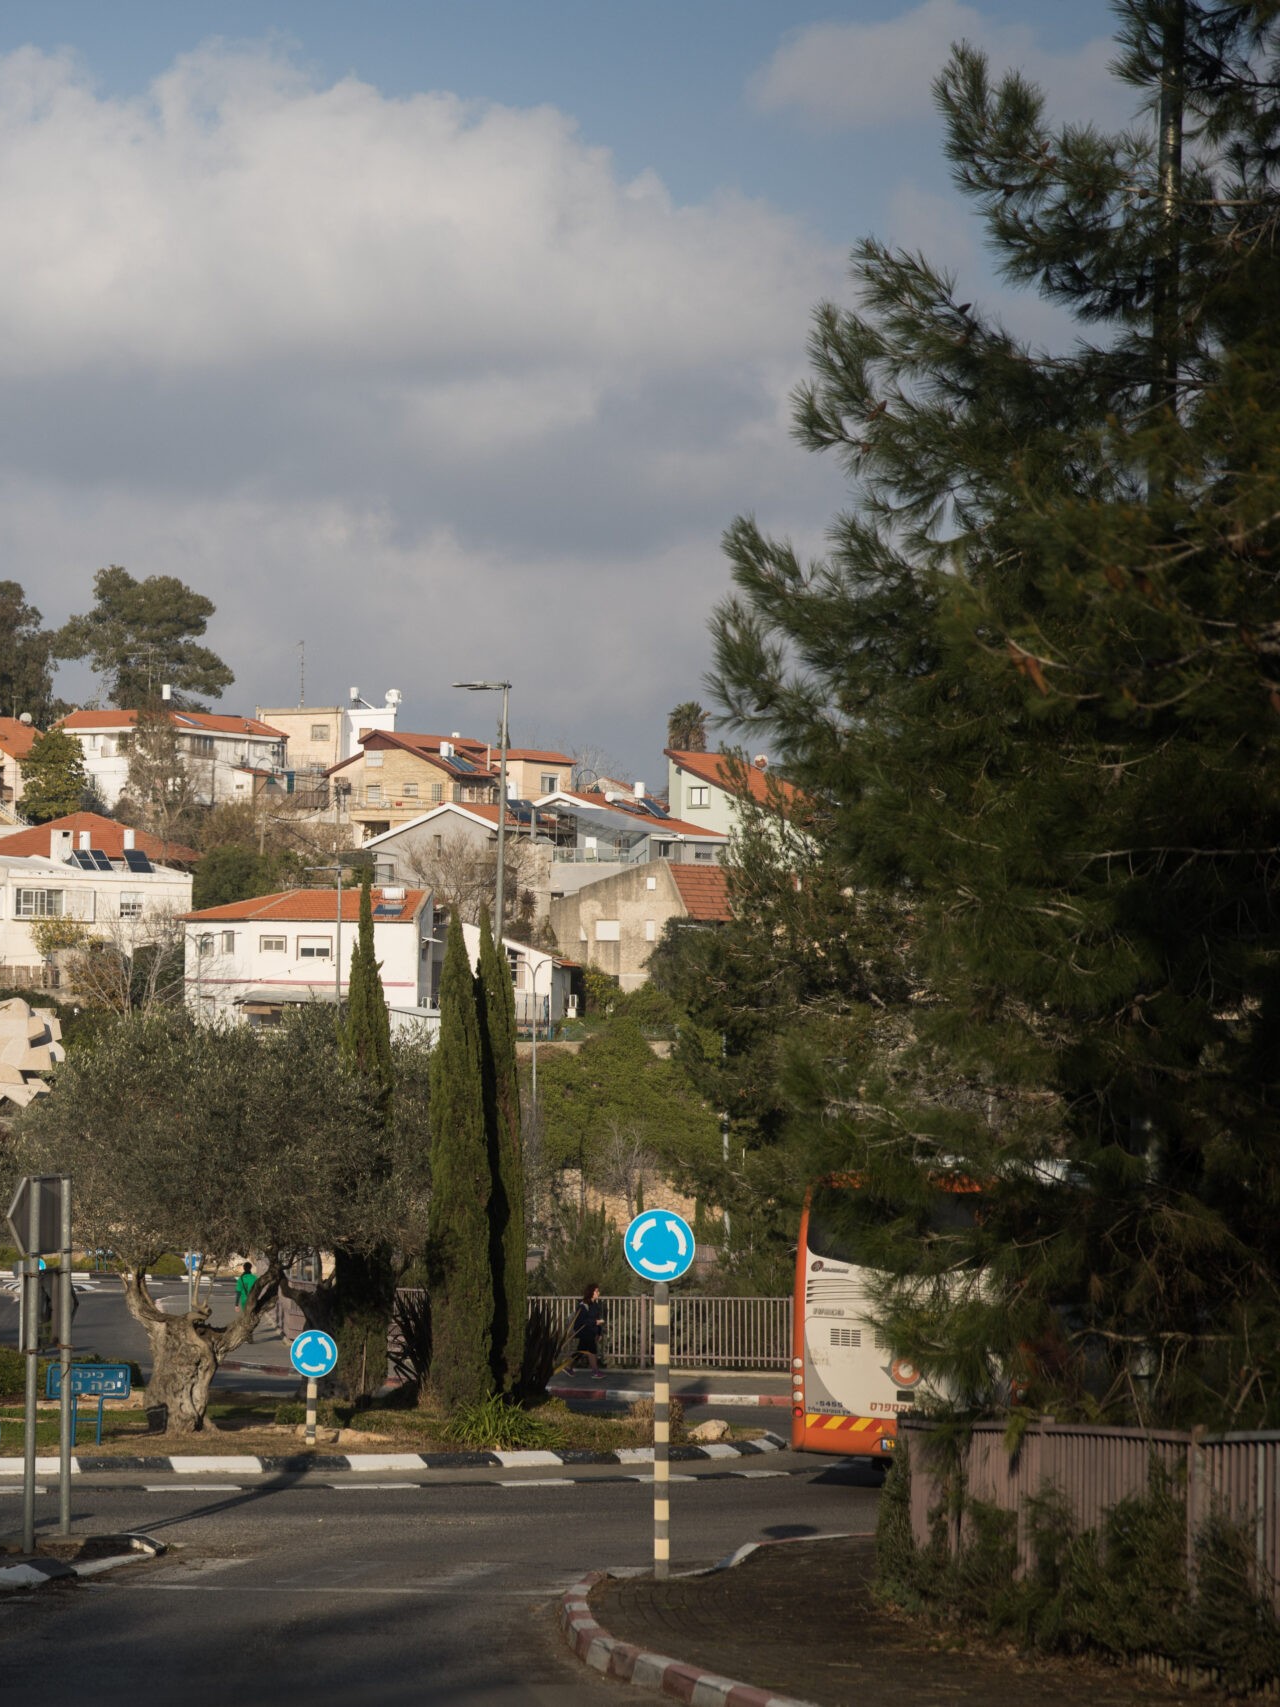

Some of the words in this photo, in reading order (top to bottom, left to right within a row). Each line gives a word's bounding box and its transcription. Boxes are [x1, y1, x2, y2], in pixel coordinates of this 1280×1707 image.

[74, 1371, 104, 1379] כיכר
[55, 1381, 82, 1391] נו
[91, 1381, 122, 1391] יפה
